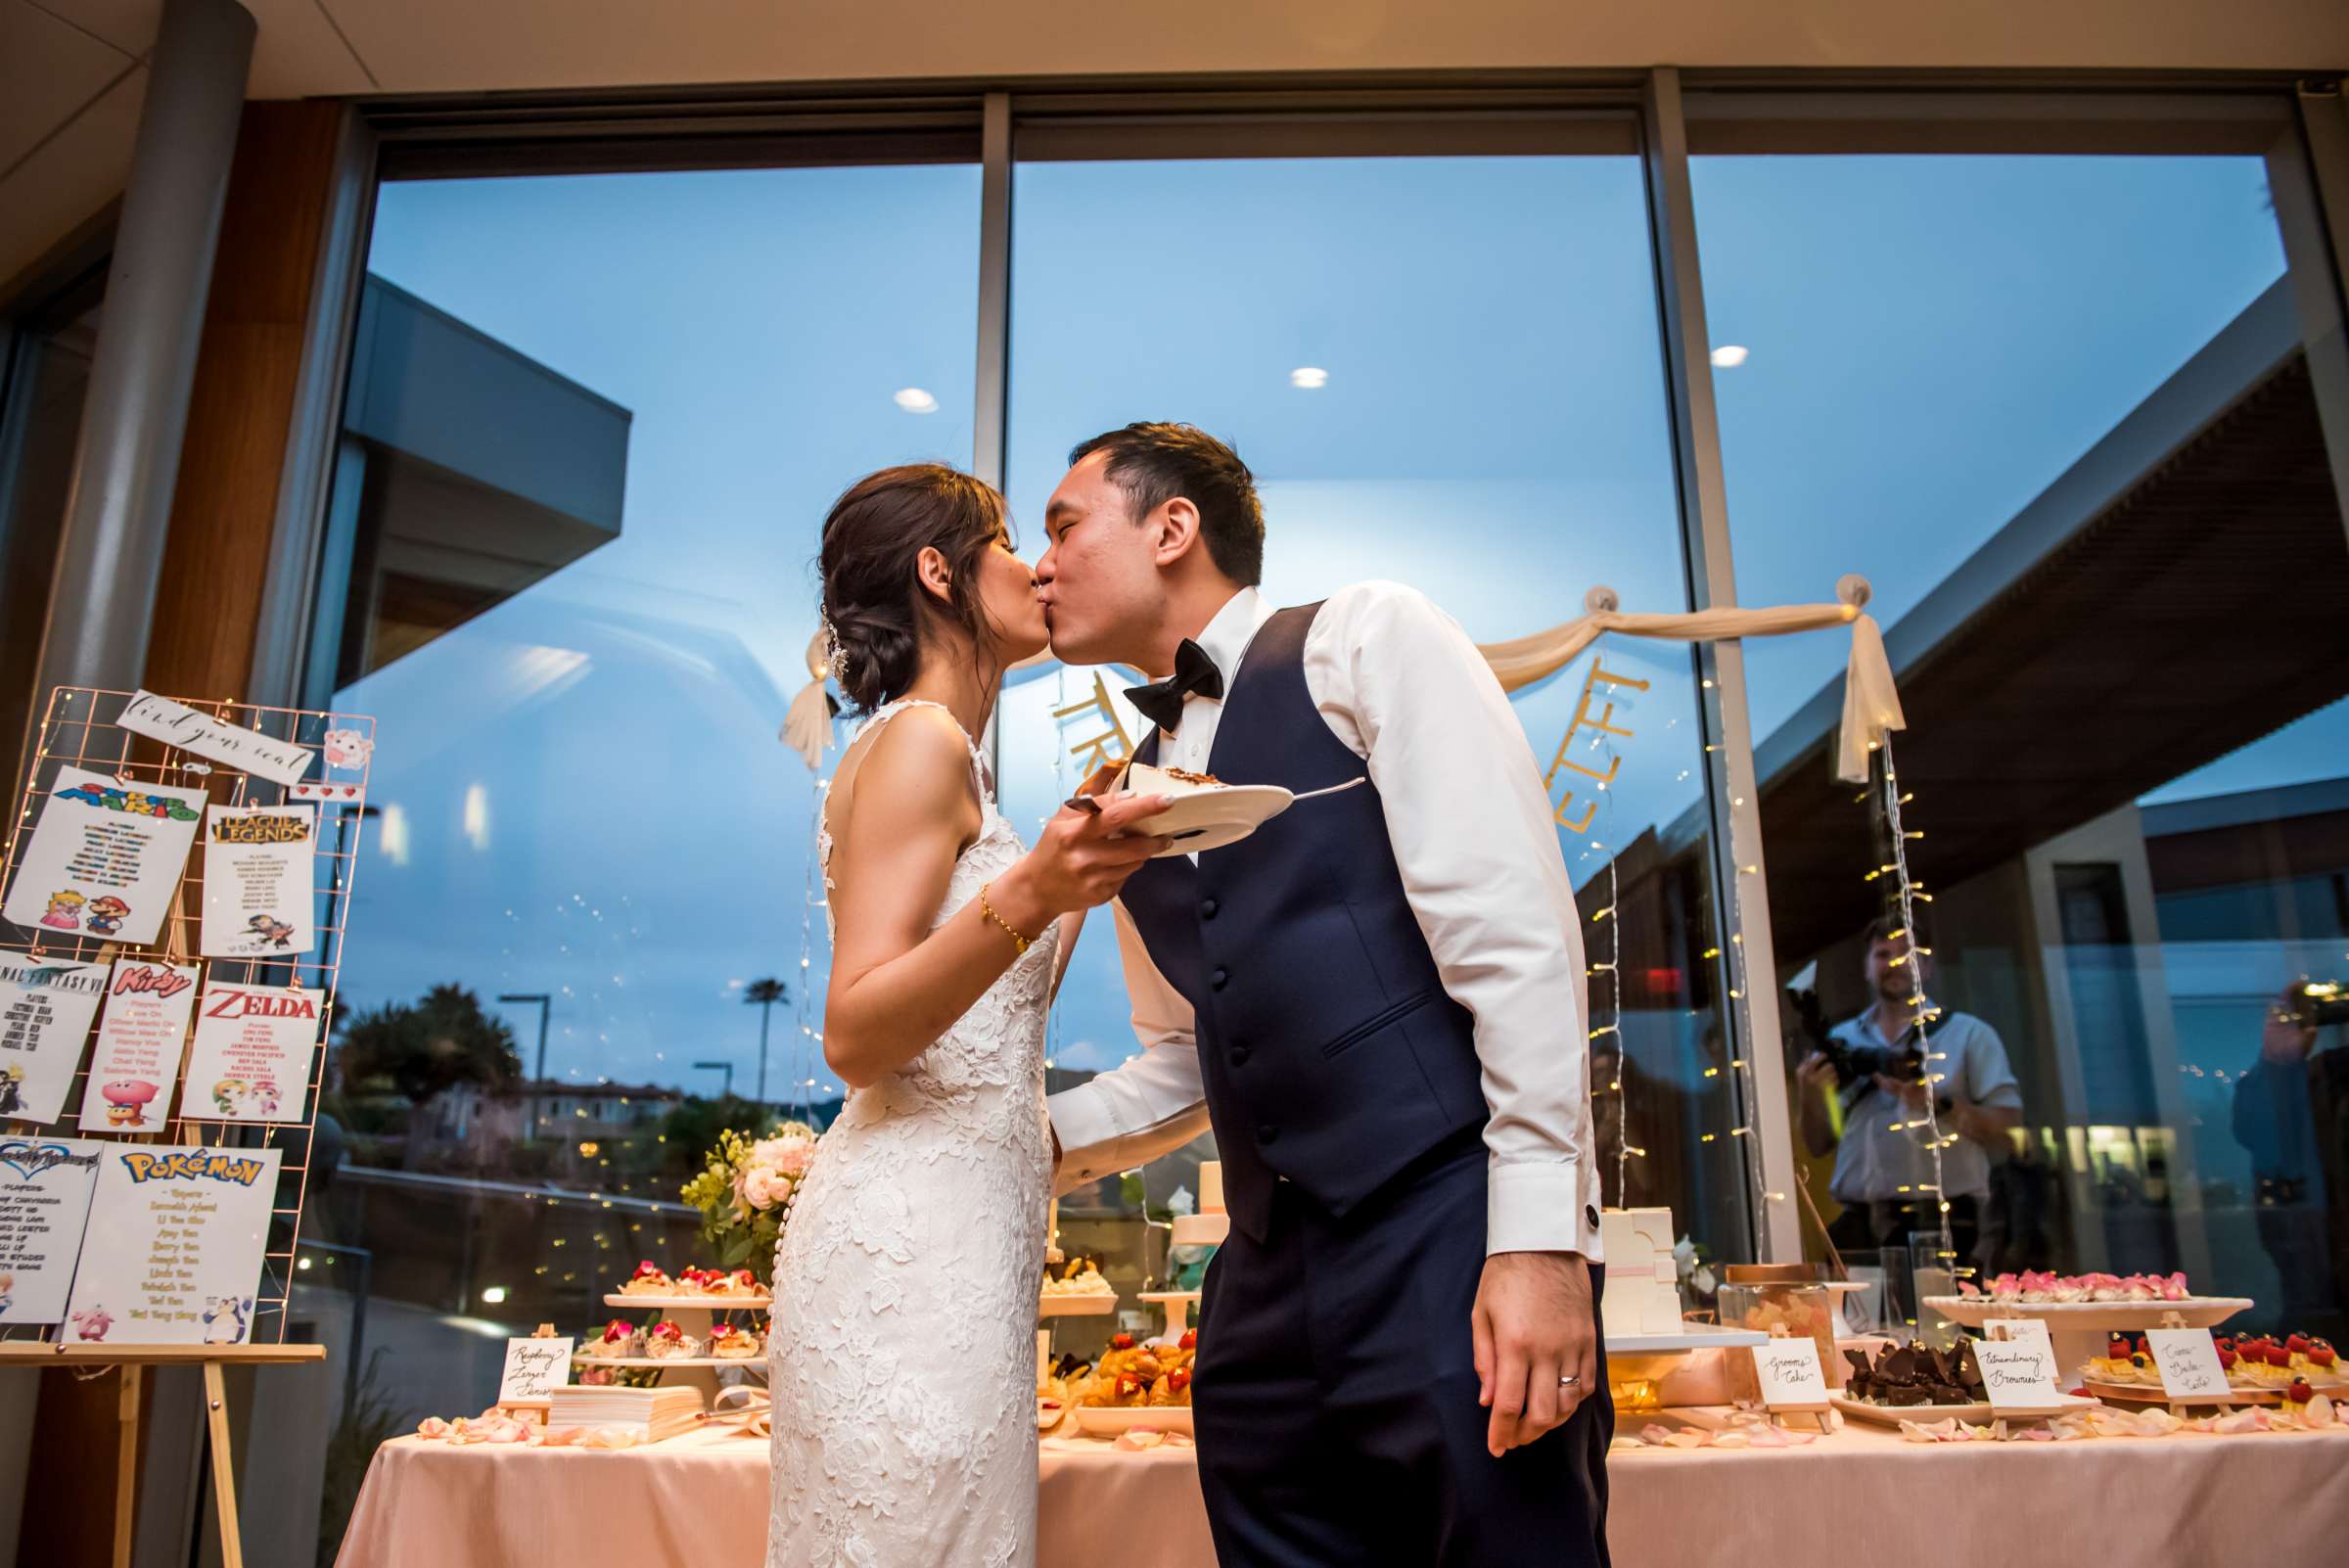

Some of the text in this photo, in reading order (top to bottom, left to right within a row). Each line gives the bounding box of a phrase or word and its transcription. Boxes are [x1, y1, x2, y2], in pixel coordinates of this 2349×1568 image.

[127, 695, 308, 769] find your seat
[53, 788, 200, 821] MARIO
[224, 815, 291, 830] LEAGUE
[214, 824, 309, 844] LEGENDS
[28, 969, 88, 990] FANTASY
[114, 966, 192, 998] Kirby
[205, 989, 316, 1020] ZELDA
[1781, 1369, 1815, 1384] Cake
[1989, 1369, 2047, 1388] Brownies
